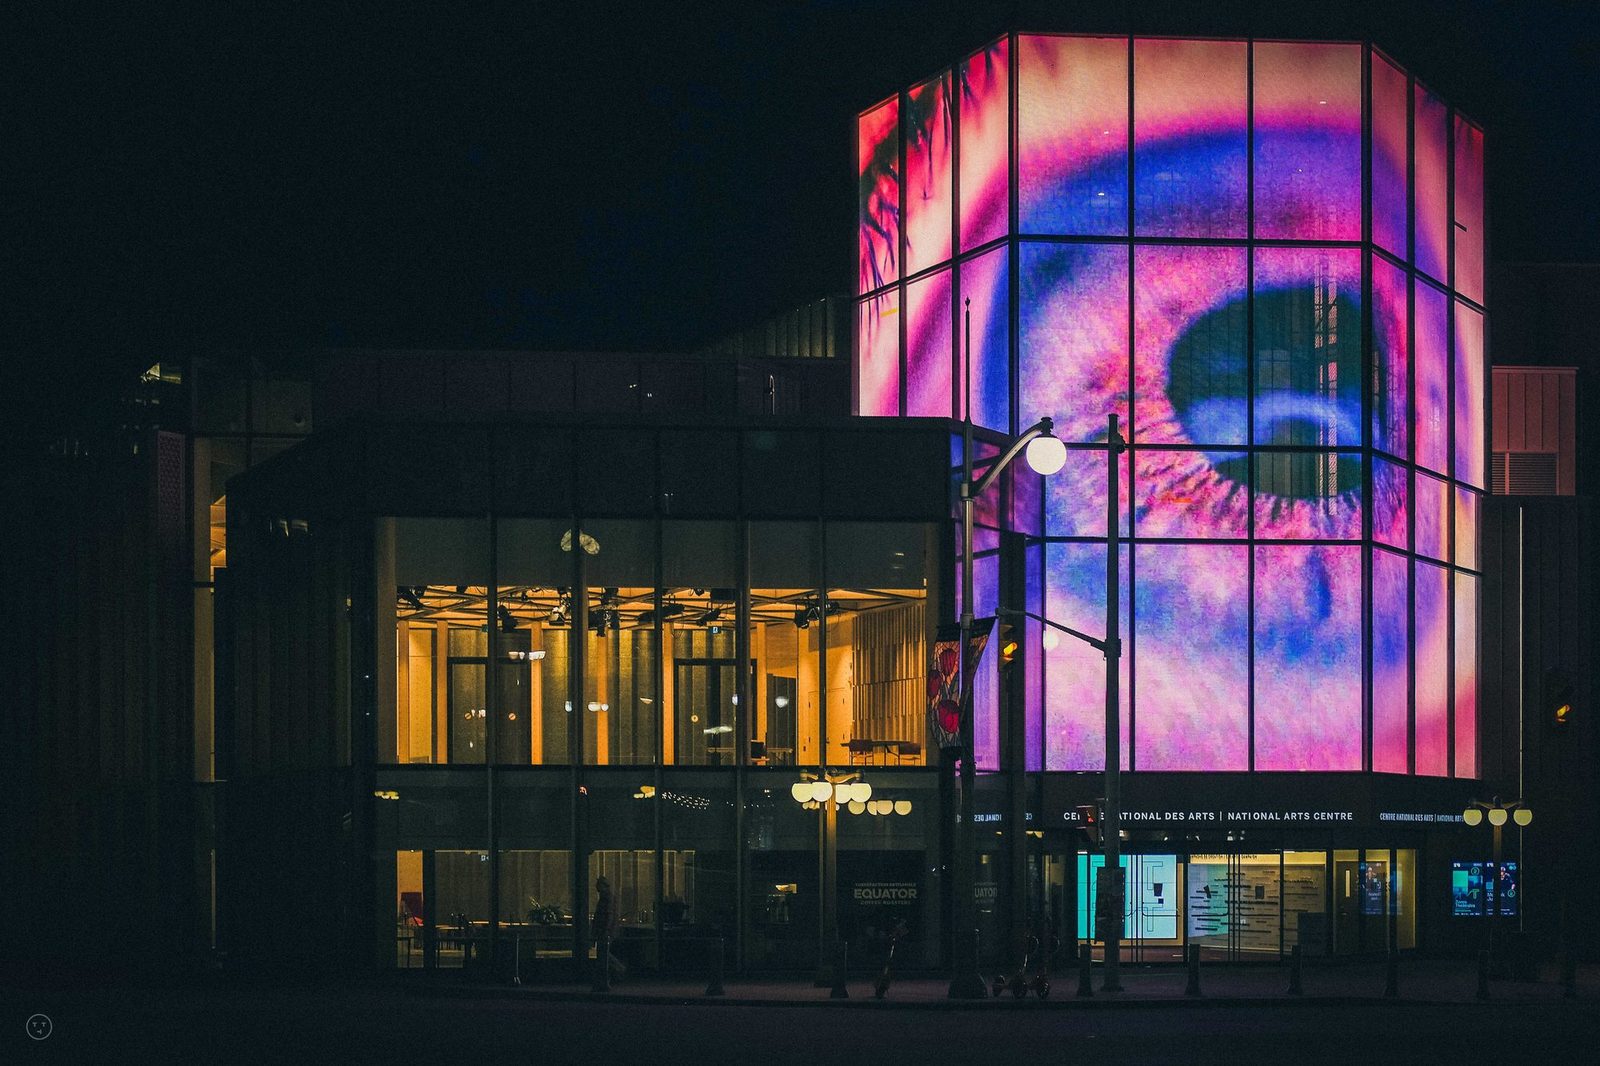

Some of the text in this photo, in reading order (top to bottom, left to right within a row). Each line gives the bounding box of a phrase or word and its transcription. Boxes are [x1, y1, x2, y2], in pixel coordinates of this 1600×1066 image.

[1063, 811, 1353, 821] CEE TIONAL DES ARTS NATIONAL ARTS CENTRE
[1379, 812, 1396, 821] CENTRE
[854, 888, 918, 899] EQUATOR
